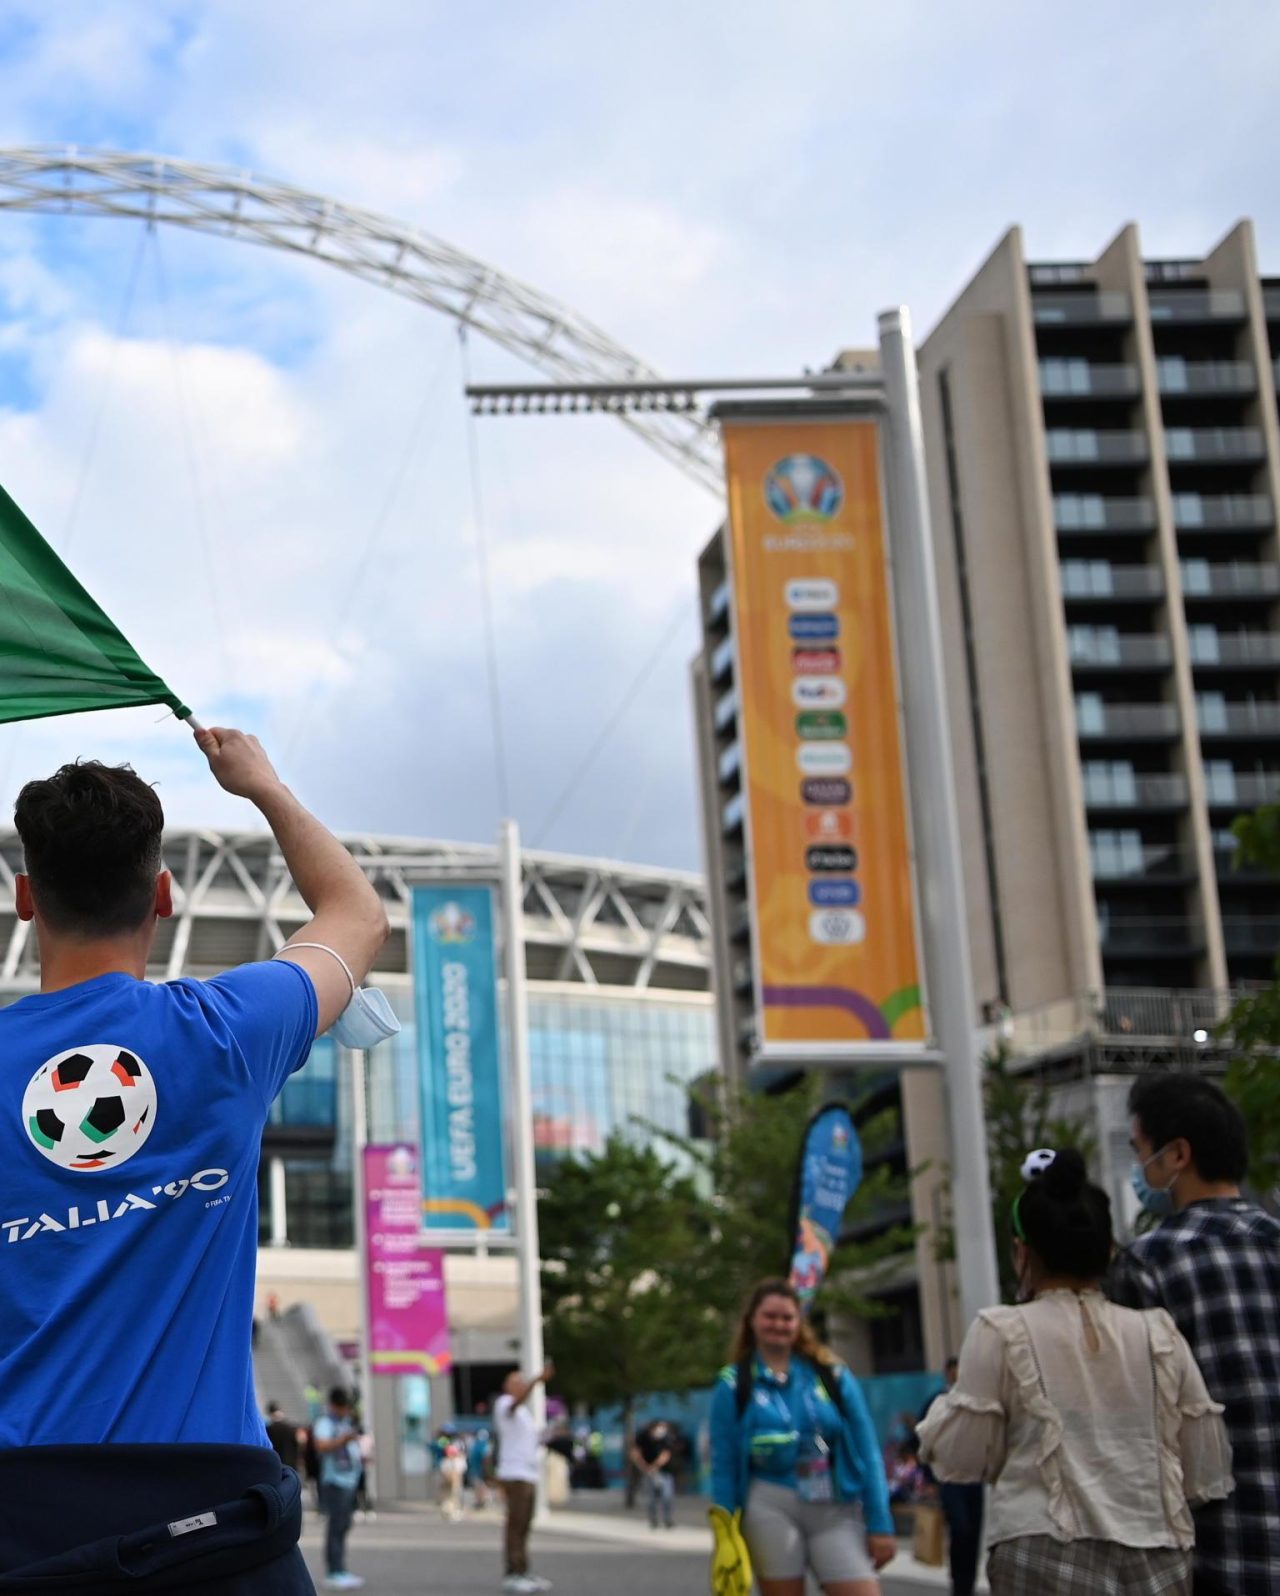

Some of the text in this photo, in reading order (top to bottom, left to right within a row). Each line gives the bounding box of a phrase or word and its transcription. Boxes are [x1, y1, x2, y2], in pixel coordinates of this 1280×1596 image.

[441, 961, 477, 1182] UEFA EURO 2020
